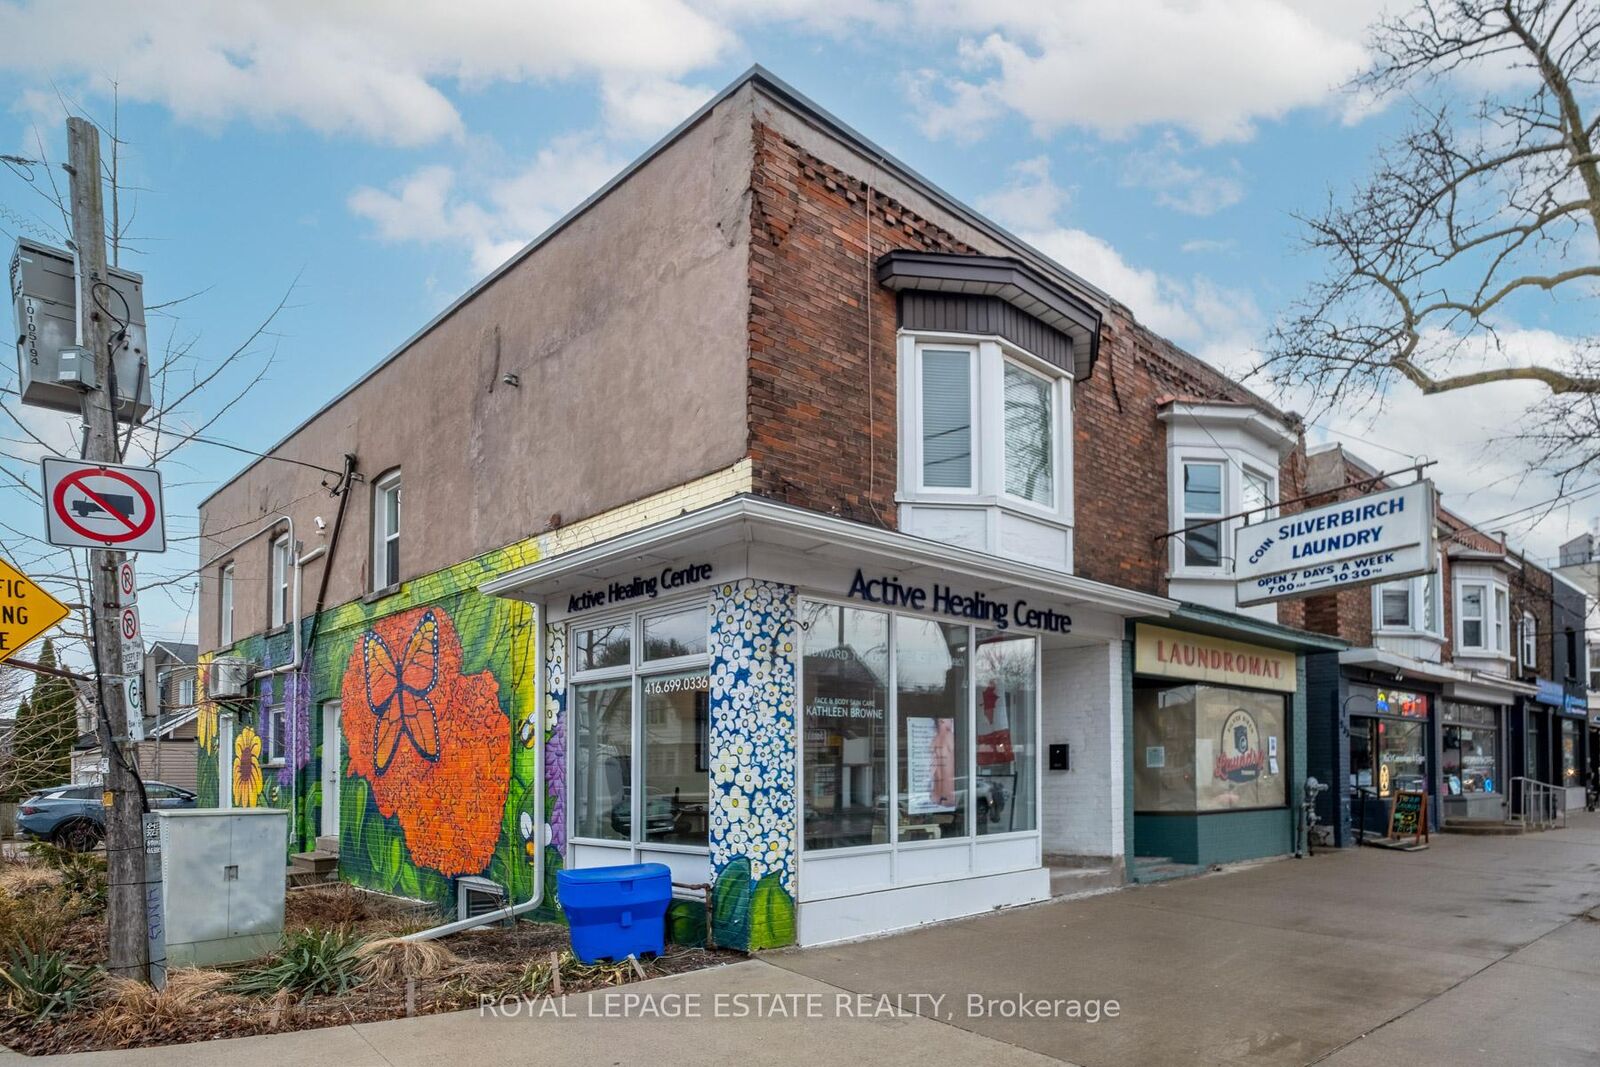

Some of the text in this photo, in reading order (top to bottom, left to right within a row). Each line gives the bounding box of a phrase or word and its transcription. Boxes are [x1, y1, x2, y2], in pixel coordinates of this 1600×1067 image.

[26, 298, 39, 366] 10105194
[1278, 496, 1405, 541] SILVERBIRCH
[1249, 537, 1275, 565] COIN
[1292, 525, 1384, 560] LAUNDRY
[1258, 552, 1394, 588] OPEN 7 DAYS A WEEK
[567, 563, 713, 613] Active Healing Centre
[847, 567, 1073, 635] Active Healing Centre
[1157, 639, 1281, 680] LAUNDROMAT
[644, 674, 708, 695] 416.699.0336
[814, 696, 828, 705] FACE
[806, 705, 884, 720] KATHLEEN BROWNE
[1214, 748, 1265, 781] Laundry
